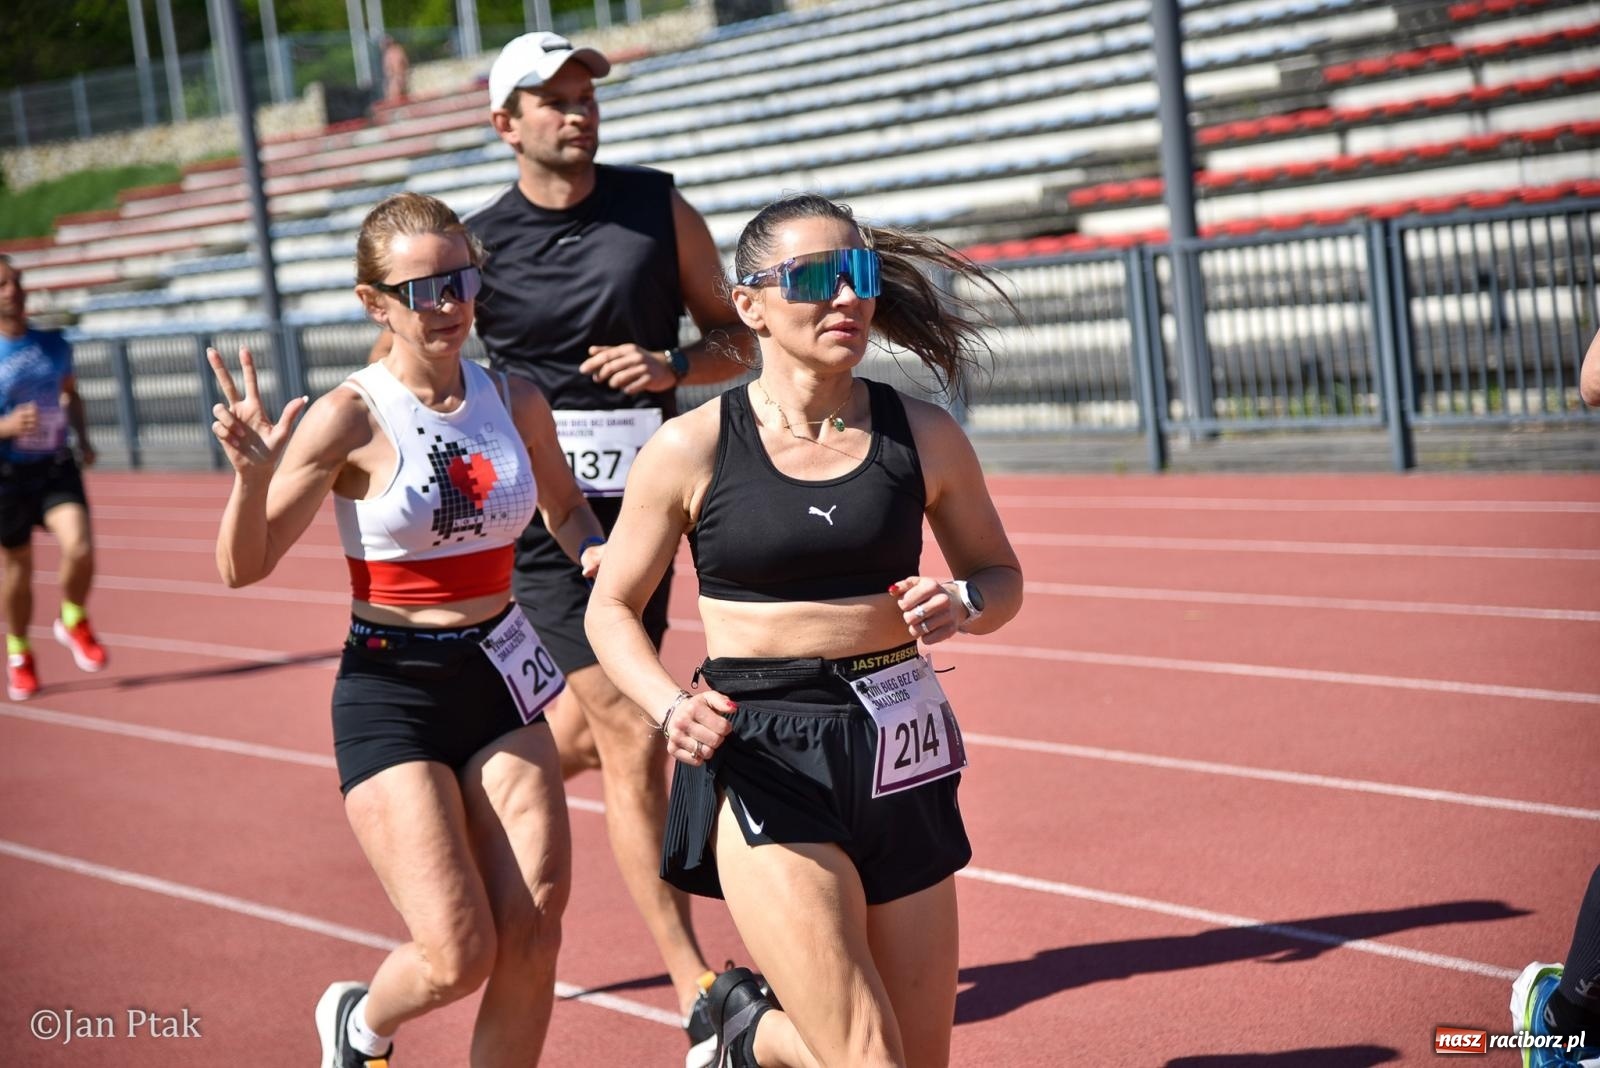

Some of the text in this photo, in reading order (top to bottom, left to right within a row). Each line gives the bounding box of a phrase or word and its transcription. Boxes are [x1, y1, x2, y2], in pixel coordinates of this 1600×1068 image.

[567, 451, 621, 479] 137
[880, 677, 899, 693] BIEG
[897, 672, 912, 687] BEZ
[871, 688, 911, 711] 3MAJA2026
[894, 712, 940, 770] 214
